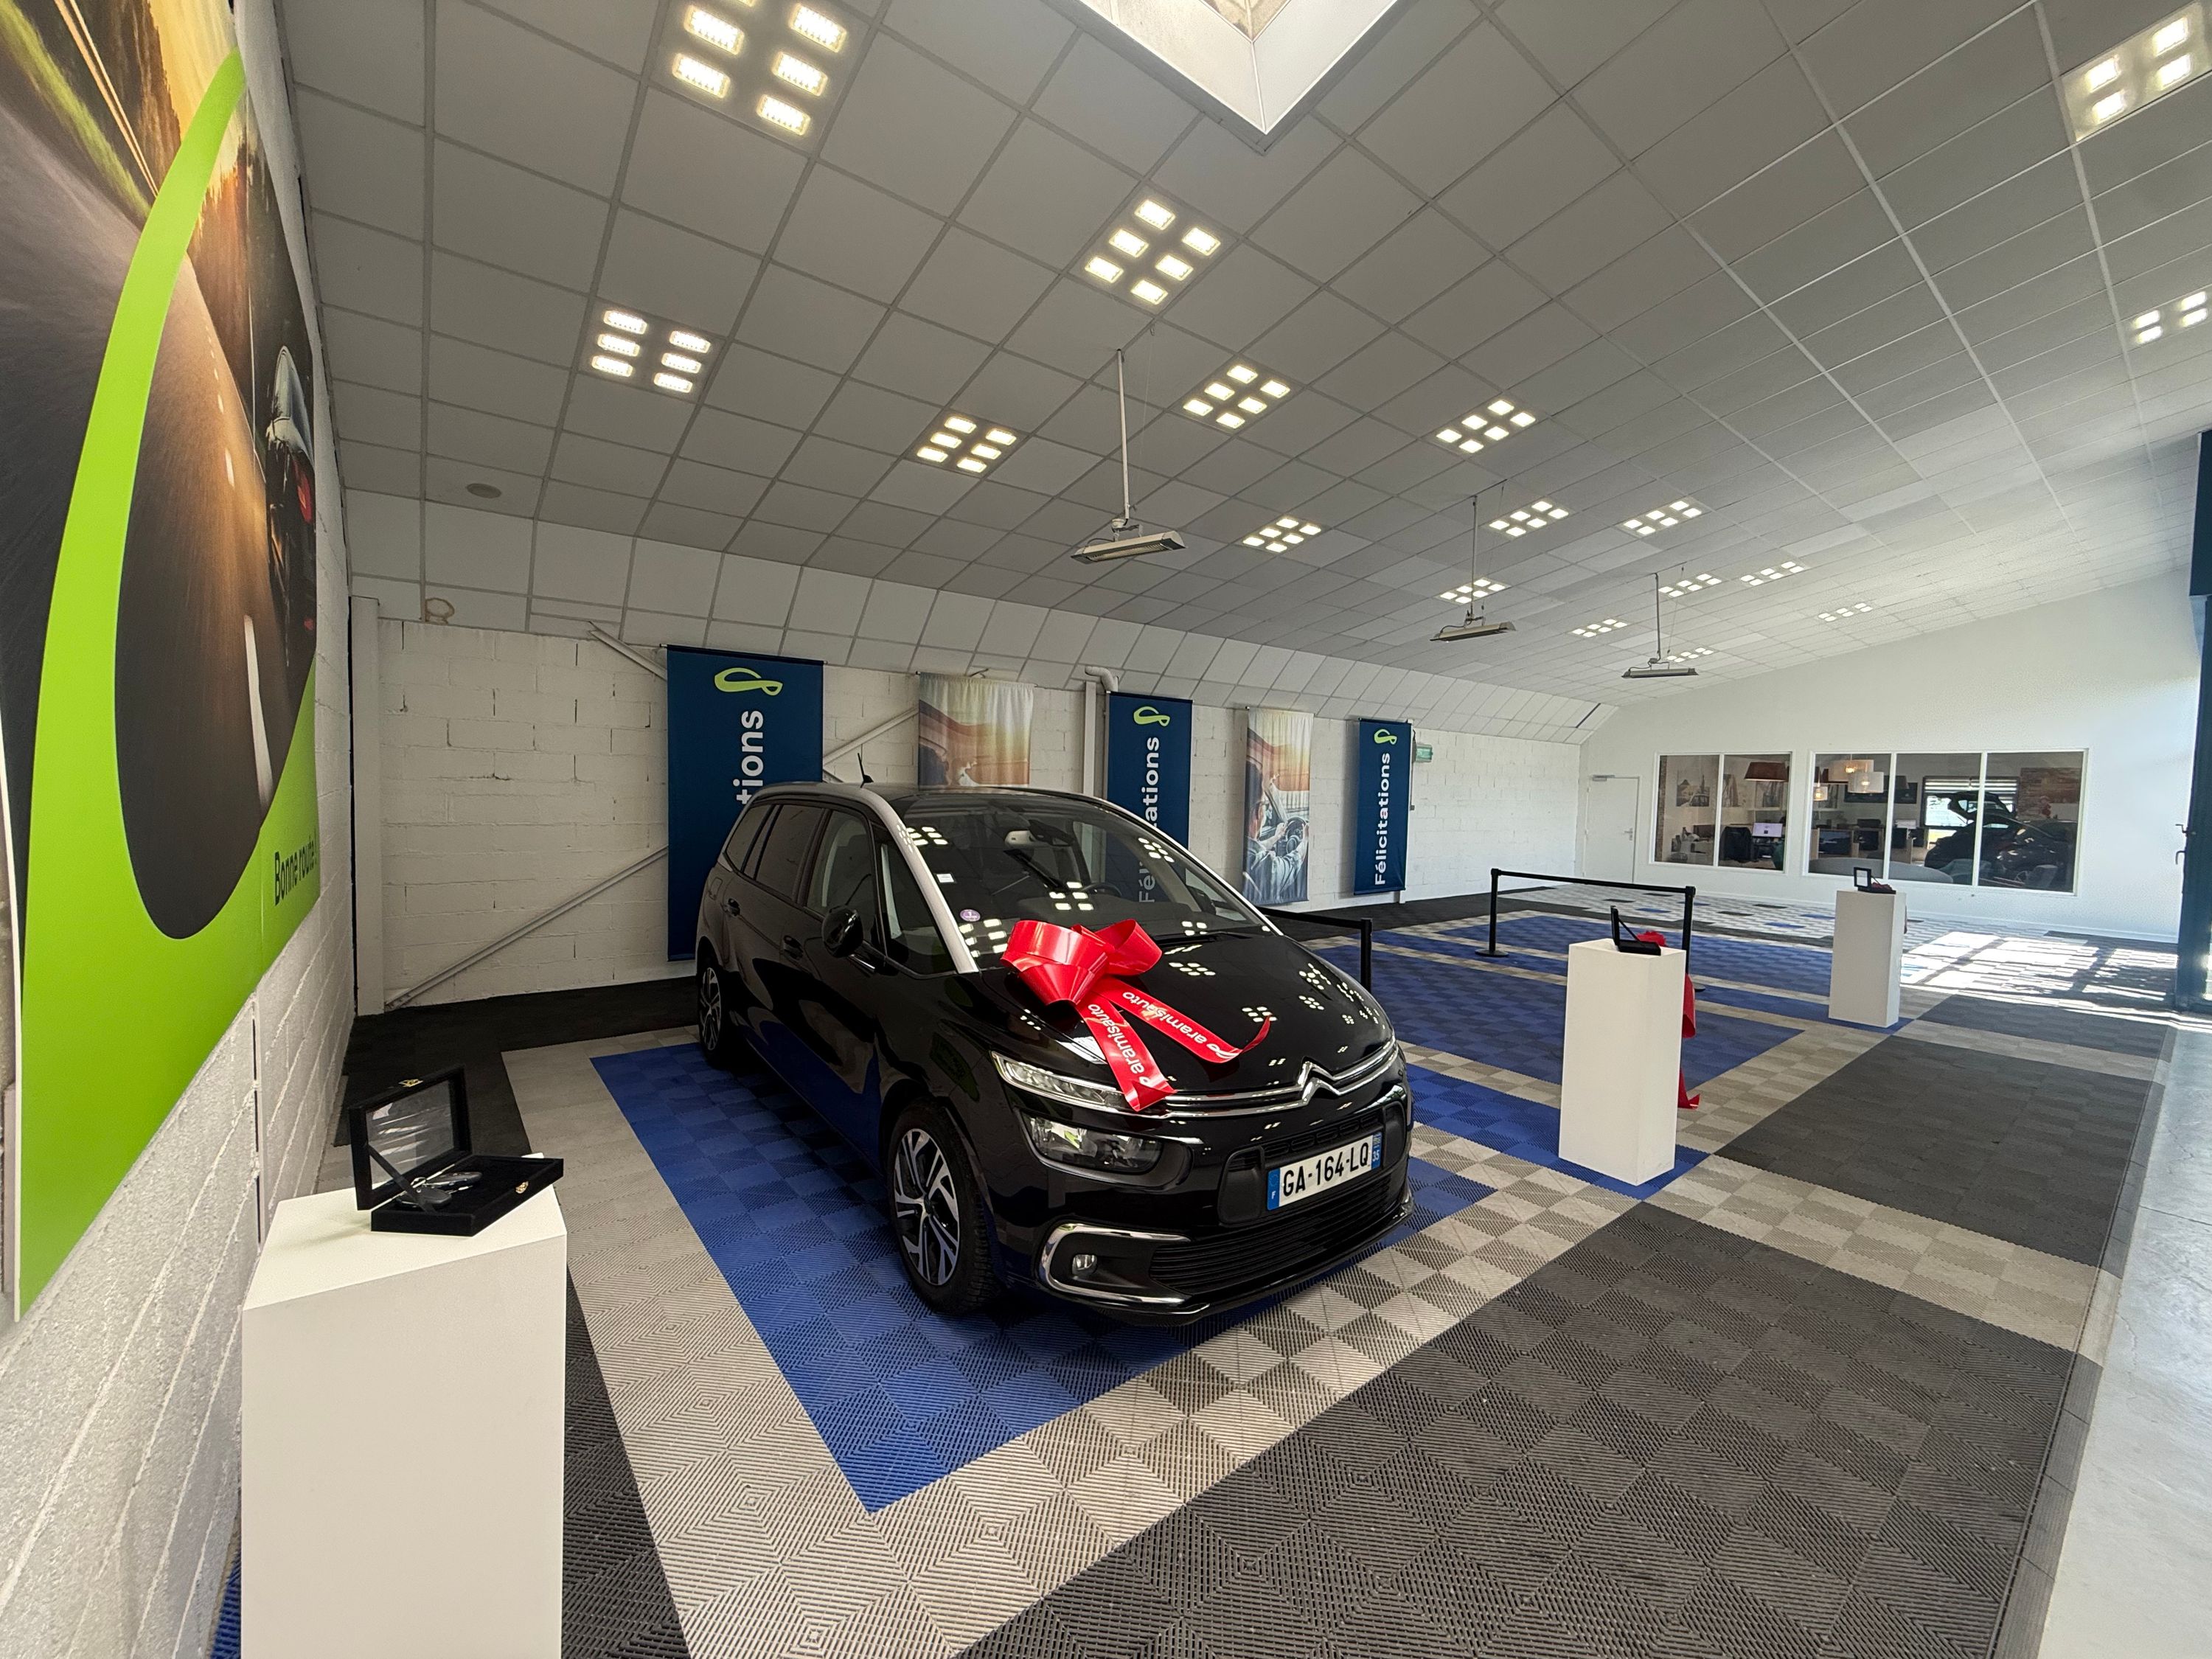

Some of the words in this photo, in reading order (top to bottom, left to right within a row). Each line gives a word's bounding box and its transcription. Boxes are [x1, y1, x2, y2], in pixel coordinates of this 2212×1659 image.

[1375, 753, 1391, 885] Félicitations
[275, 852, 298, 906] Bonne
[299, 835, 314, 881] route
[1088, 1004, 1145, 1074] aramisauto
[1123, 991, 1208, 1043] aramisauto
[1271, 1191, 1276, 1199] F
[1283, 1142, 1369, 1197] GA-164-LQ
[1372, 1150, 1380, 1161] 35
